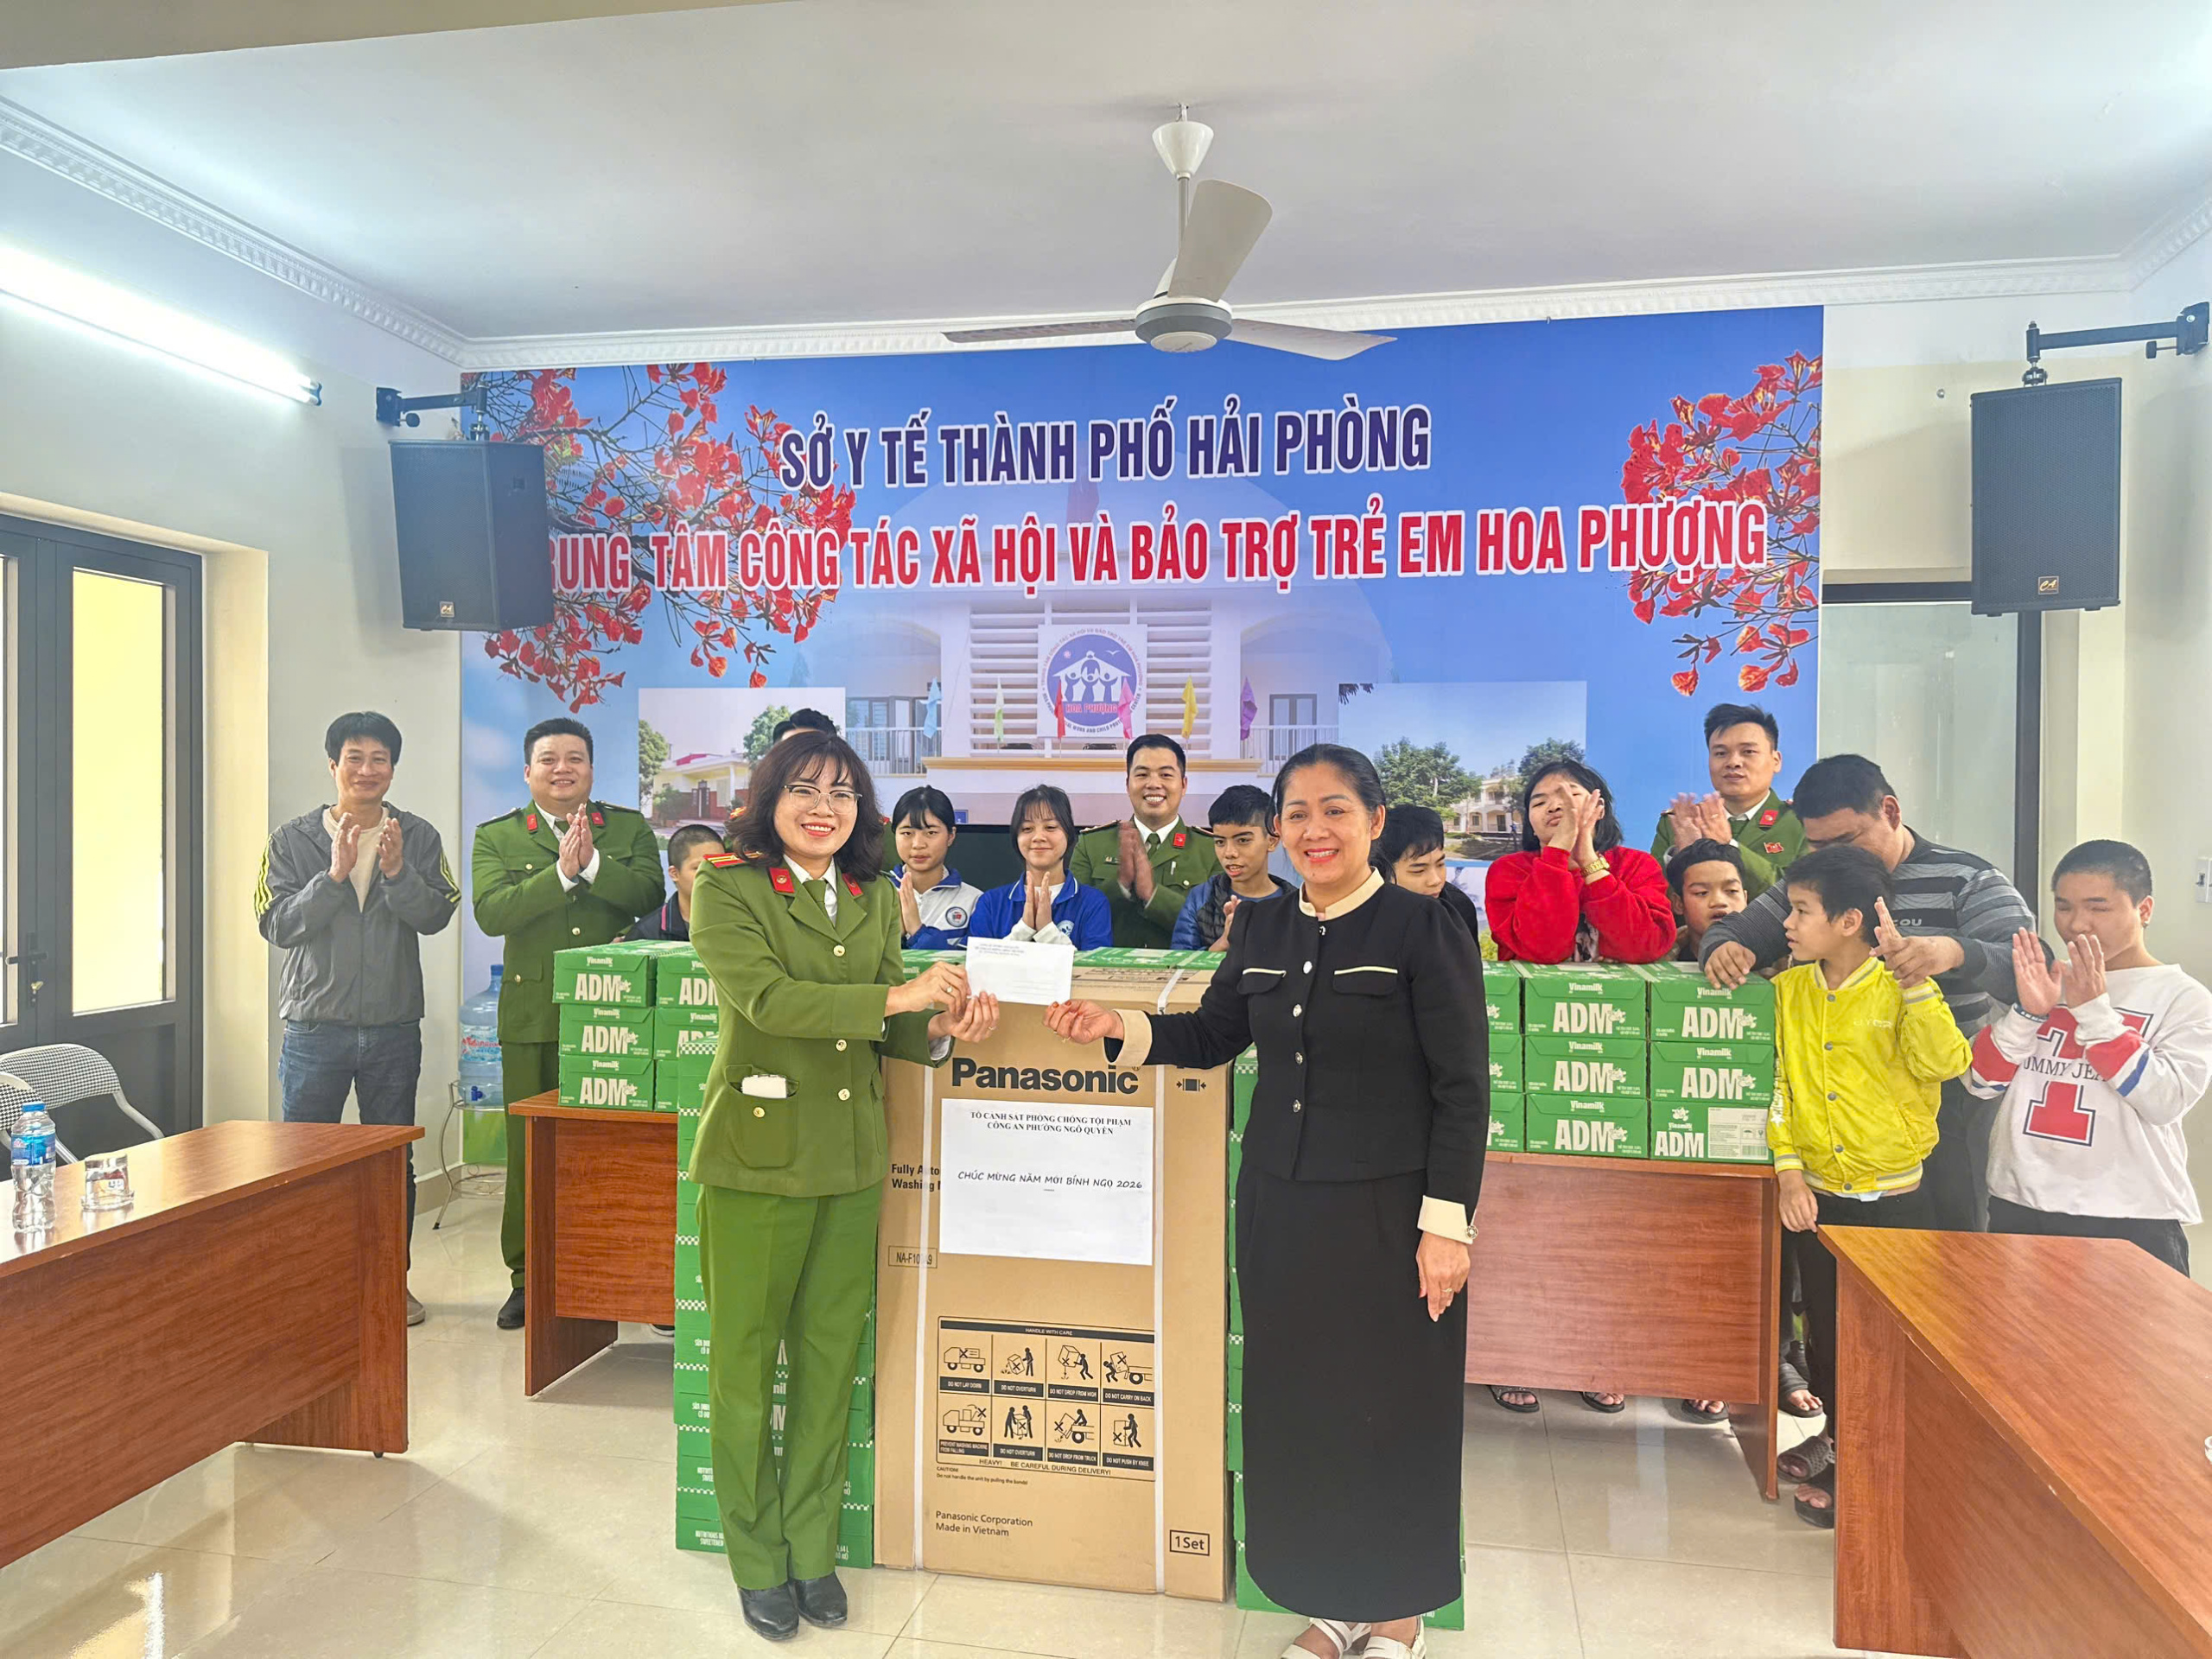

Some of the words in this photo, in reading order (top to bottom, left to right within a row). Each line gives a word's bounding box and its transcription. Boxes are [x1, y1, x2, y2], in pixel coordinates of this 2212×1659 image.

[780, 412, 834, 488] SỞ
[845, 430, 868, 486] Y
[880, 410, 930, 486] TẾ
[939, 413, 1075, 484] THÀNH
[1090, 397, 1176, 479] PHỐ
[1188, 396, 1261, 476] HẢI
[1275, 396, 1429, 473] PHÒNG
[650, 521, 727, 589] TÂM
[739, 521, 839, 588] CÔNG
[850, 518, 918, 586] TÁC
[930, 516, 982, 585] XÃ
[994, 514, 1056, 595] HỘI
[1069, 512, 1119, 582] VÀ
[1130, 503, 1208, 581] BẢO
[1221, 513, 1299, 590] TRỢ
[1310, 496, 1385, 576] TRẺ
[1399, 514, 1462, 574] EM
[1478, 510, 1565, 572] HOA
[1580, 498, 1765, 581] PHƯỢNG
[575, 973, 621, 1002] ADM
[1568, 982, 1603, 995] Vinamilk
[593, 1007, 620, 1019] Vinamilk
[690, 1012, 718, 1023] Vinamilk
[1552, 1001, 1613, 1034] ADM
[1681, 1006, 1745, 1039] ADM
[581, 1025, 629, 1054] ADM
[1568, 1040, 1604, 1054] Vinamilk
[1696, 1046, 1732, 1060] Vinamilk
[592, 1059, 620, 1071] Vinamilk
[951, 1057, 1139, 1095] Panasonic
[1553, 1060, 1614, 1094] ADM
[1681, 1066, 1744, 1100] ADM
[579, 1077, 628, 1106] ADM
[1570, 1100, 1605, 1113] Vinamilk
[1554, 1119, 1615, 1153] ADM
[1654, 1130, 1705, 1158] ADM
[891, 1163, 915, 1176] Fully
[891, 1178, 935, 1192] Washig
[957, 1170, 984, 1180] CHÚC
[1066, 1174, 1090, 1186] BÍNH
[1116, 1180, 1143, 1189] 2026
[1077, 1467, 1111, 1476] DELIVERY!
[935, 1510, 979, 1522] Panasonic
[980, 1514, 1033, 1527] Corporation
[935, 1522, 961, 1532] Made
[963, 1524, 970, 1533] in
[972, 1525, 1009, 1536] Vietnam
